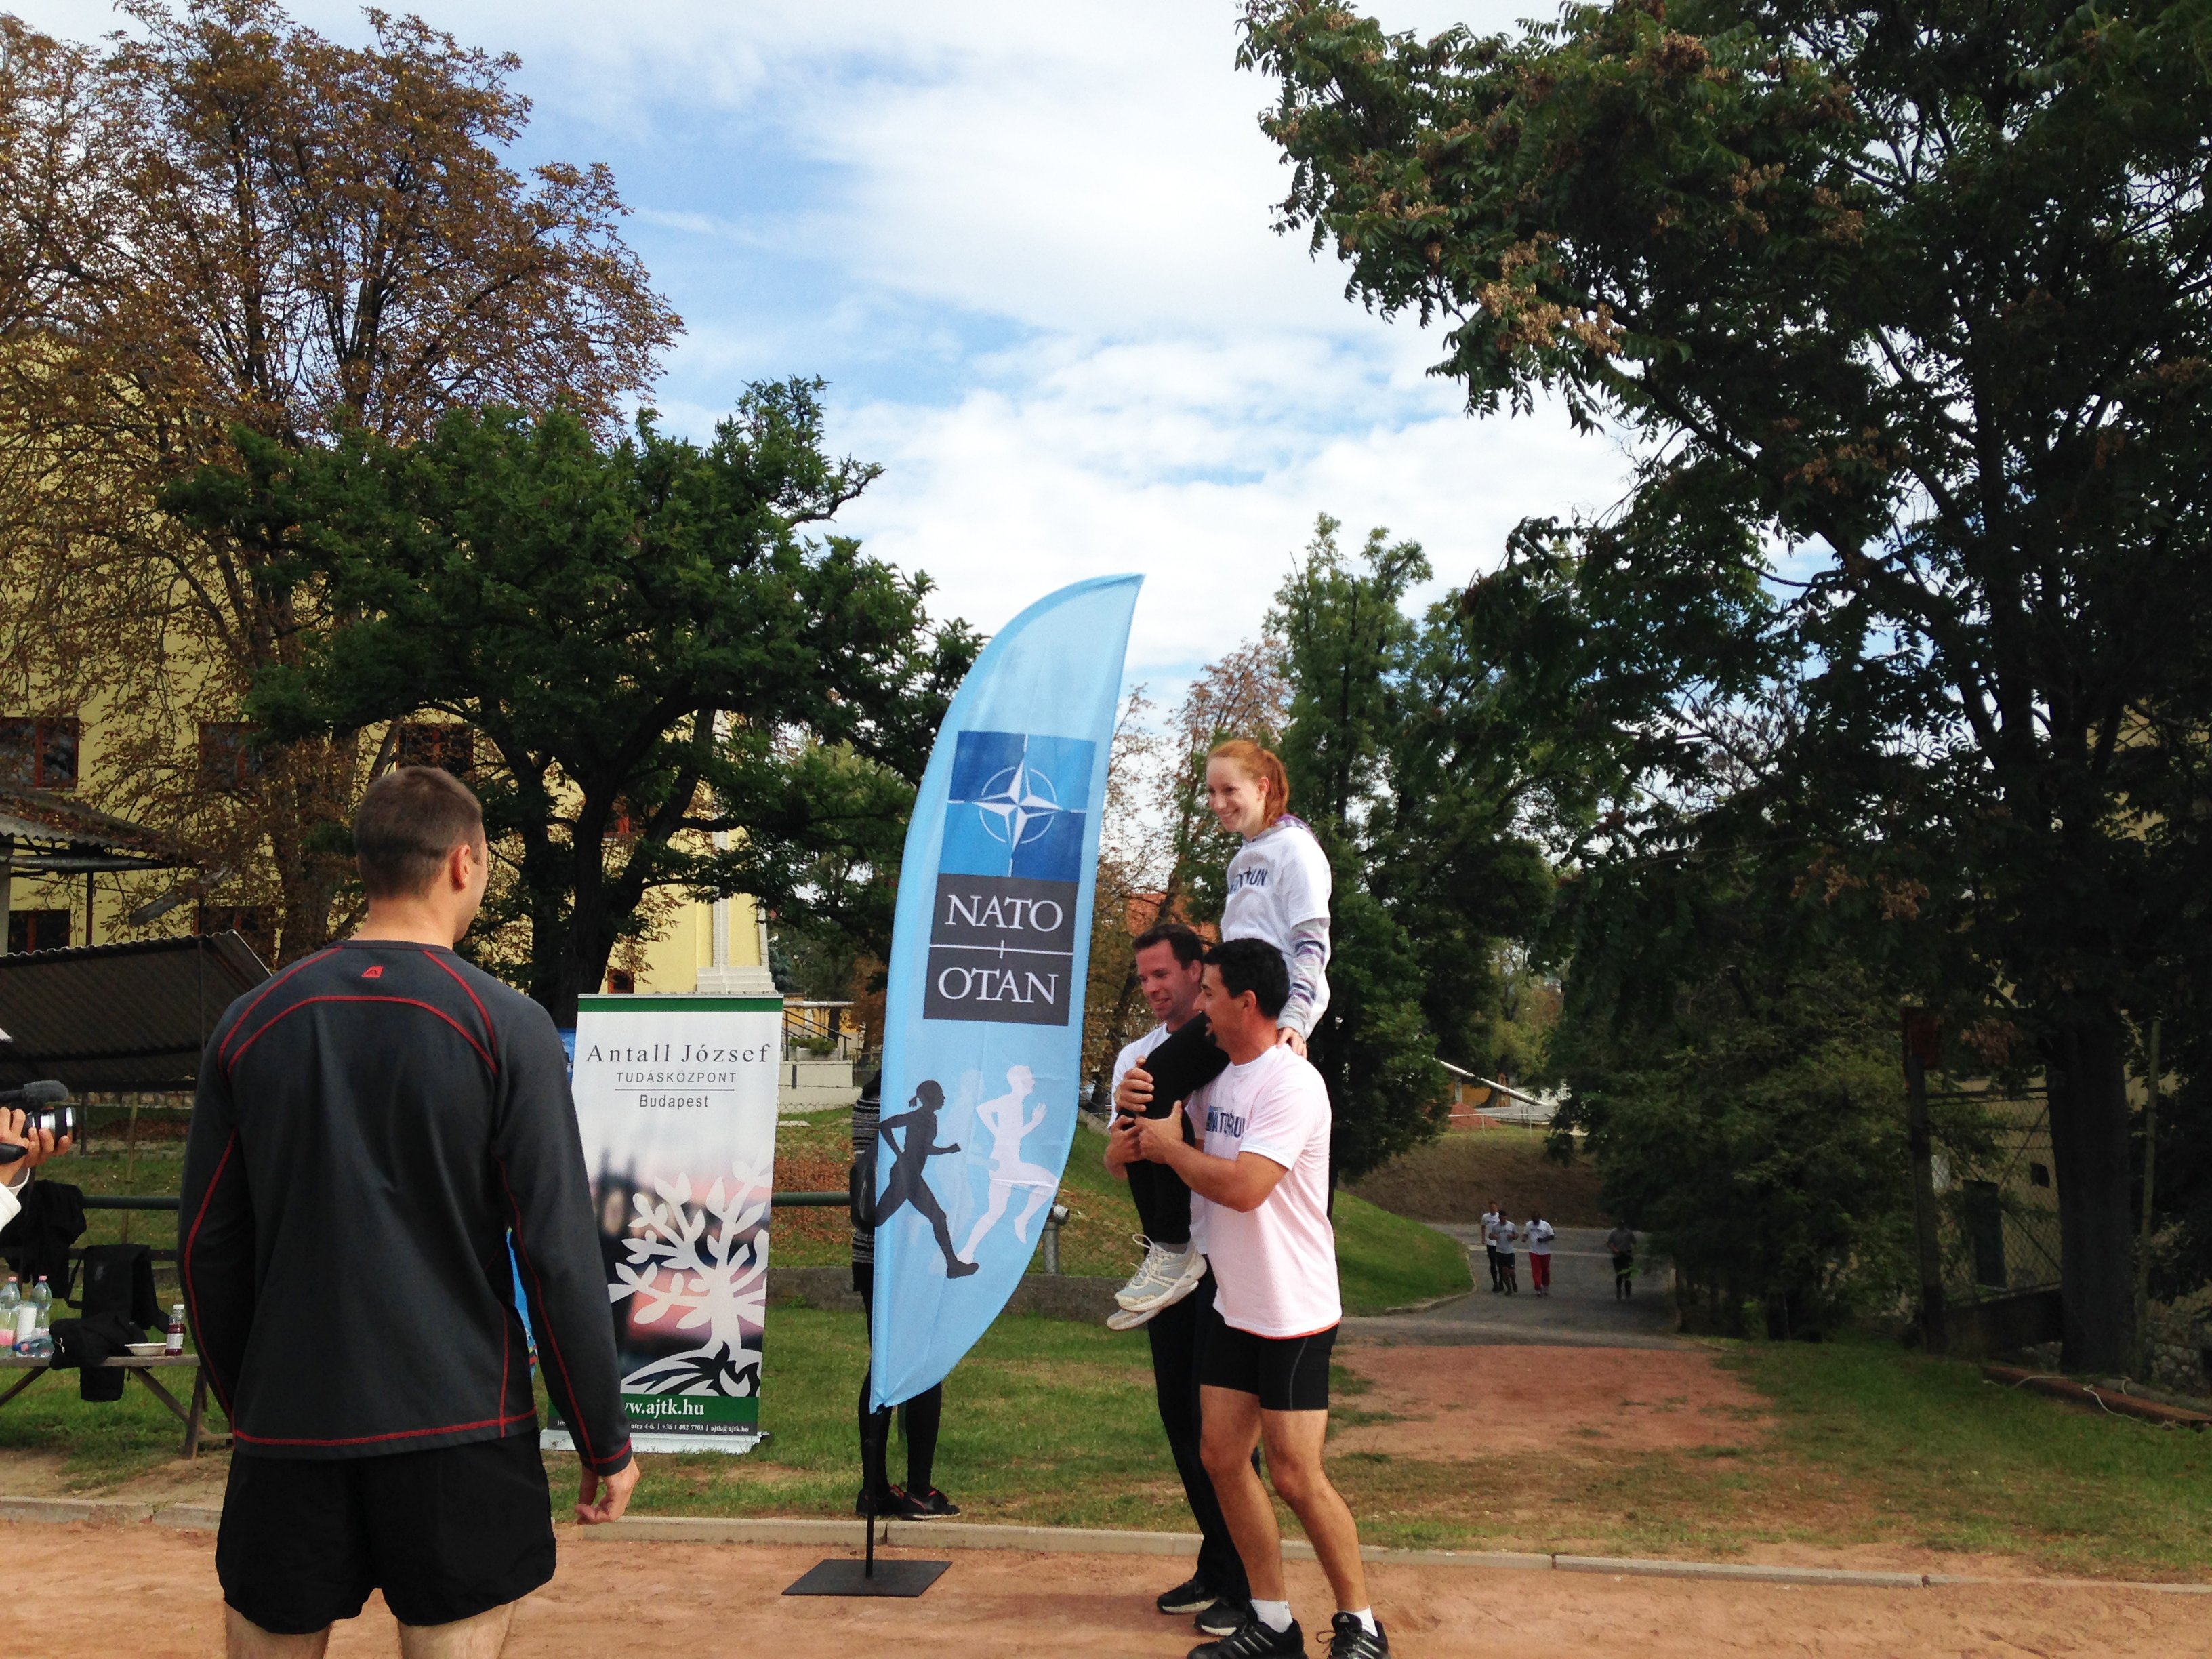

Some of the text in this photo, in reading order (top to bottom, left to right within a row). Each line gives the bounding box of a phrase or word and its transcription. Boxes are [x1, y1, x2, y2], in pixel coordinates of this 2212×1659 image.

[944, 894, 1063, 932] NATO
[937, 966, 1059, 1005] OTAN
[586, 1044, 771, 1062] Antall József
[617, 1071, 737, 1083] TUDÁSKÖZPONT
[639, 1094, 709, 1110] Budapest
[624, 1398, 705, 1420] w.ajtk.hu
